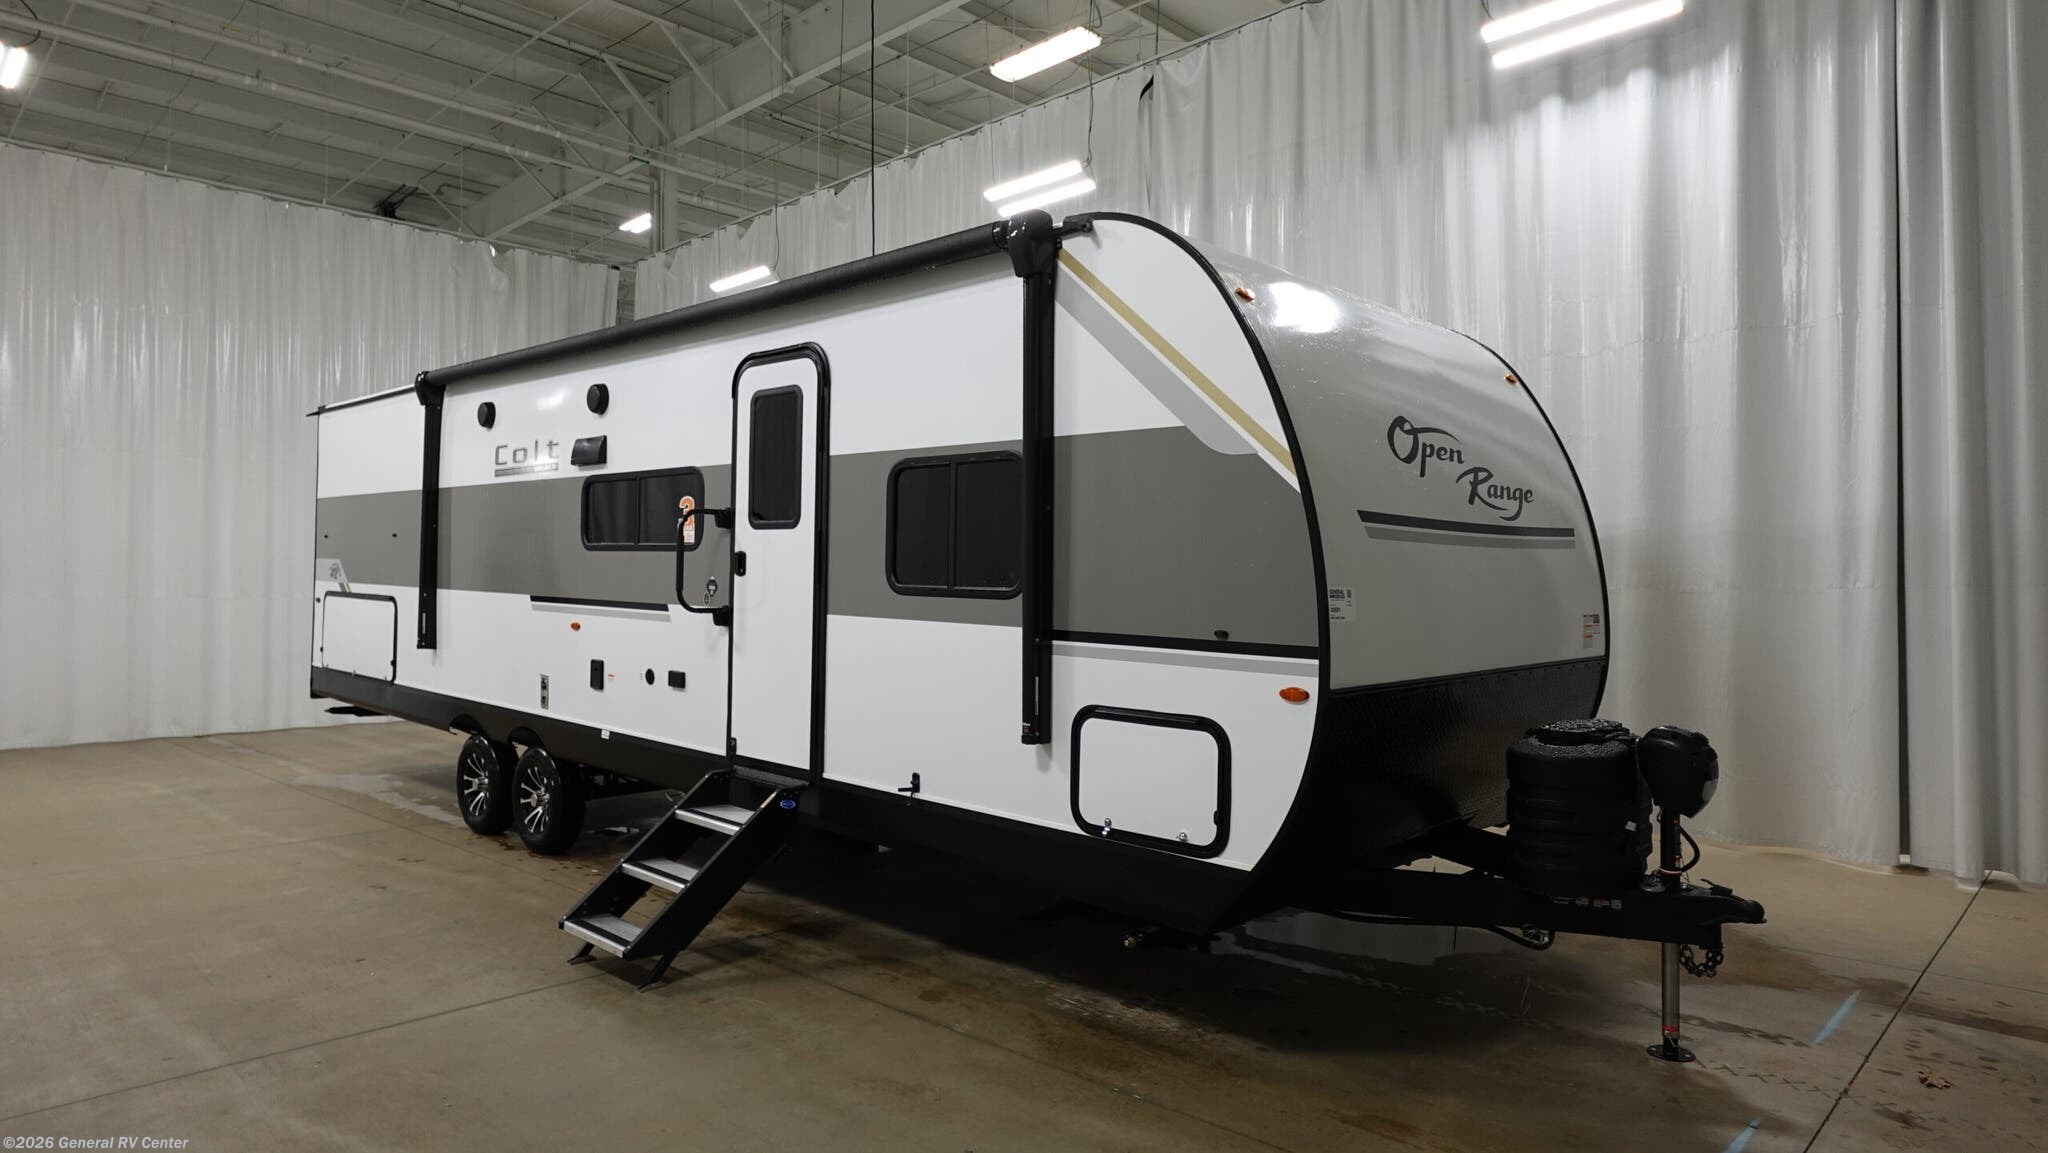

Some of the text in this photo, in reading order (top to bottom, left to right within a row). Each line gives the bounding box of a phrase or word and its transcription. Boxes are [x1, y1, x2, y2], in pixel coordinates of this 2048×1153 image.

[495, 440, 559, 465] Colt
[1387, 416, 1464, 477] Open
[1456, 467, 1534, 521] Range
